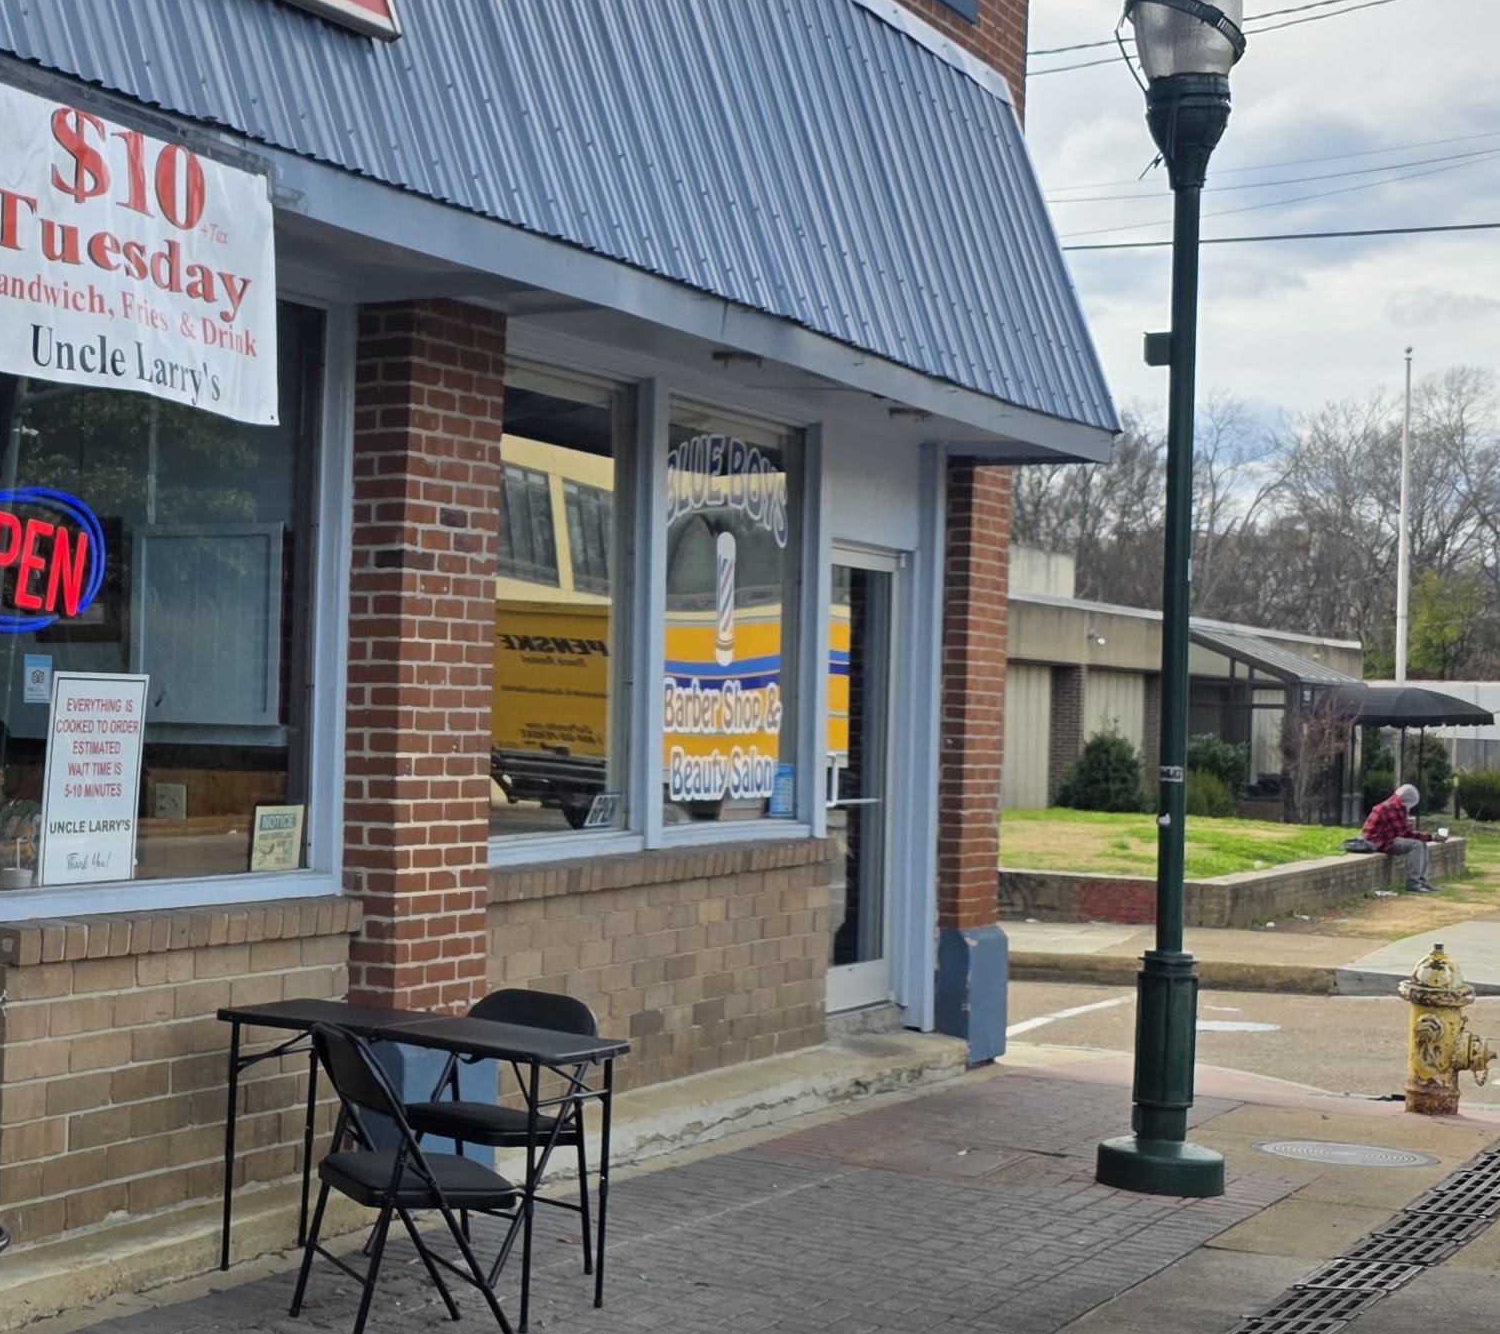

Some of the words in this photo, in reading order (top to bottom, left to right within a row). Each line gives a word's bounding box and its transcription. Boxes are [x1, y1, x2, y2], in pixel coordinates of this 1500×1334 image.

[51, 107, 206, 230] $10
[121, 291, 169, 333] Fries
[179, 312, 196, 341] &
[200, 317, 258, 358] Drink
[30, 323, 126, 377] Uncle
[134, 340, 222, 406] Larry's
[666, 434, 726, 527] BLUE
[66, 697, 122, 714] EVERYTHING
[125, 698, 134, 713] IS
[664, 677, 720, 732] Barber
[722, 679, 761, 734] Shop
[765, 683, 782, 734] &
[56, 719, 94, 735] COOKED
[96, 719, 109, 735] TO
[110, 720, 139, 735] ORDER
[72, 740, 121, 756] ESTIMATED
[68, 762, 90, 777] WAIT
[92, 762, 111, 776] TIME
[113, 762, 122, 776] IS
[669, 746, 731, 802] Beauty
[730, 746, 775, 799] Salon
[64, 783, 81, 798] 5-10
[83, 782, 122, 798] MINUTES
[49, 819, 86, 835] UNCLE
[87, 818, 131, 833] LARRY'S
[262, 814, 294, 830] NOTICE
